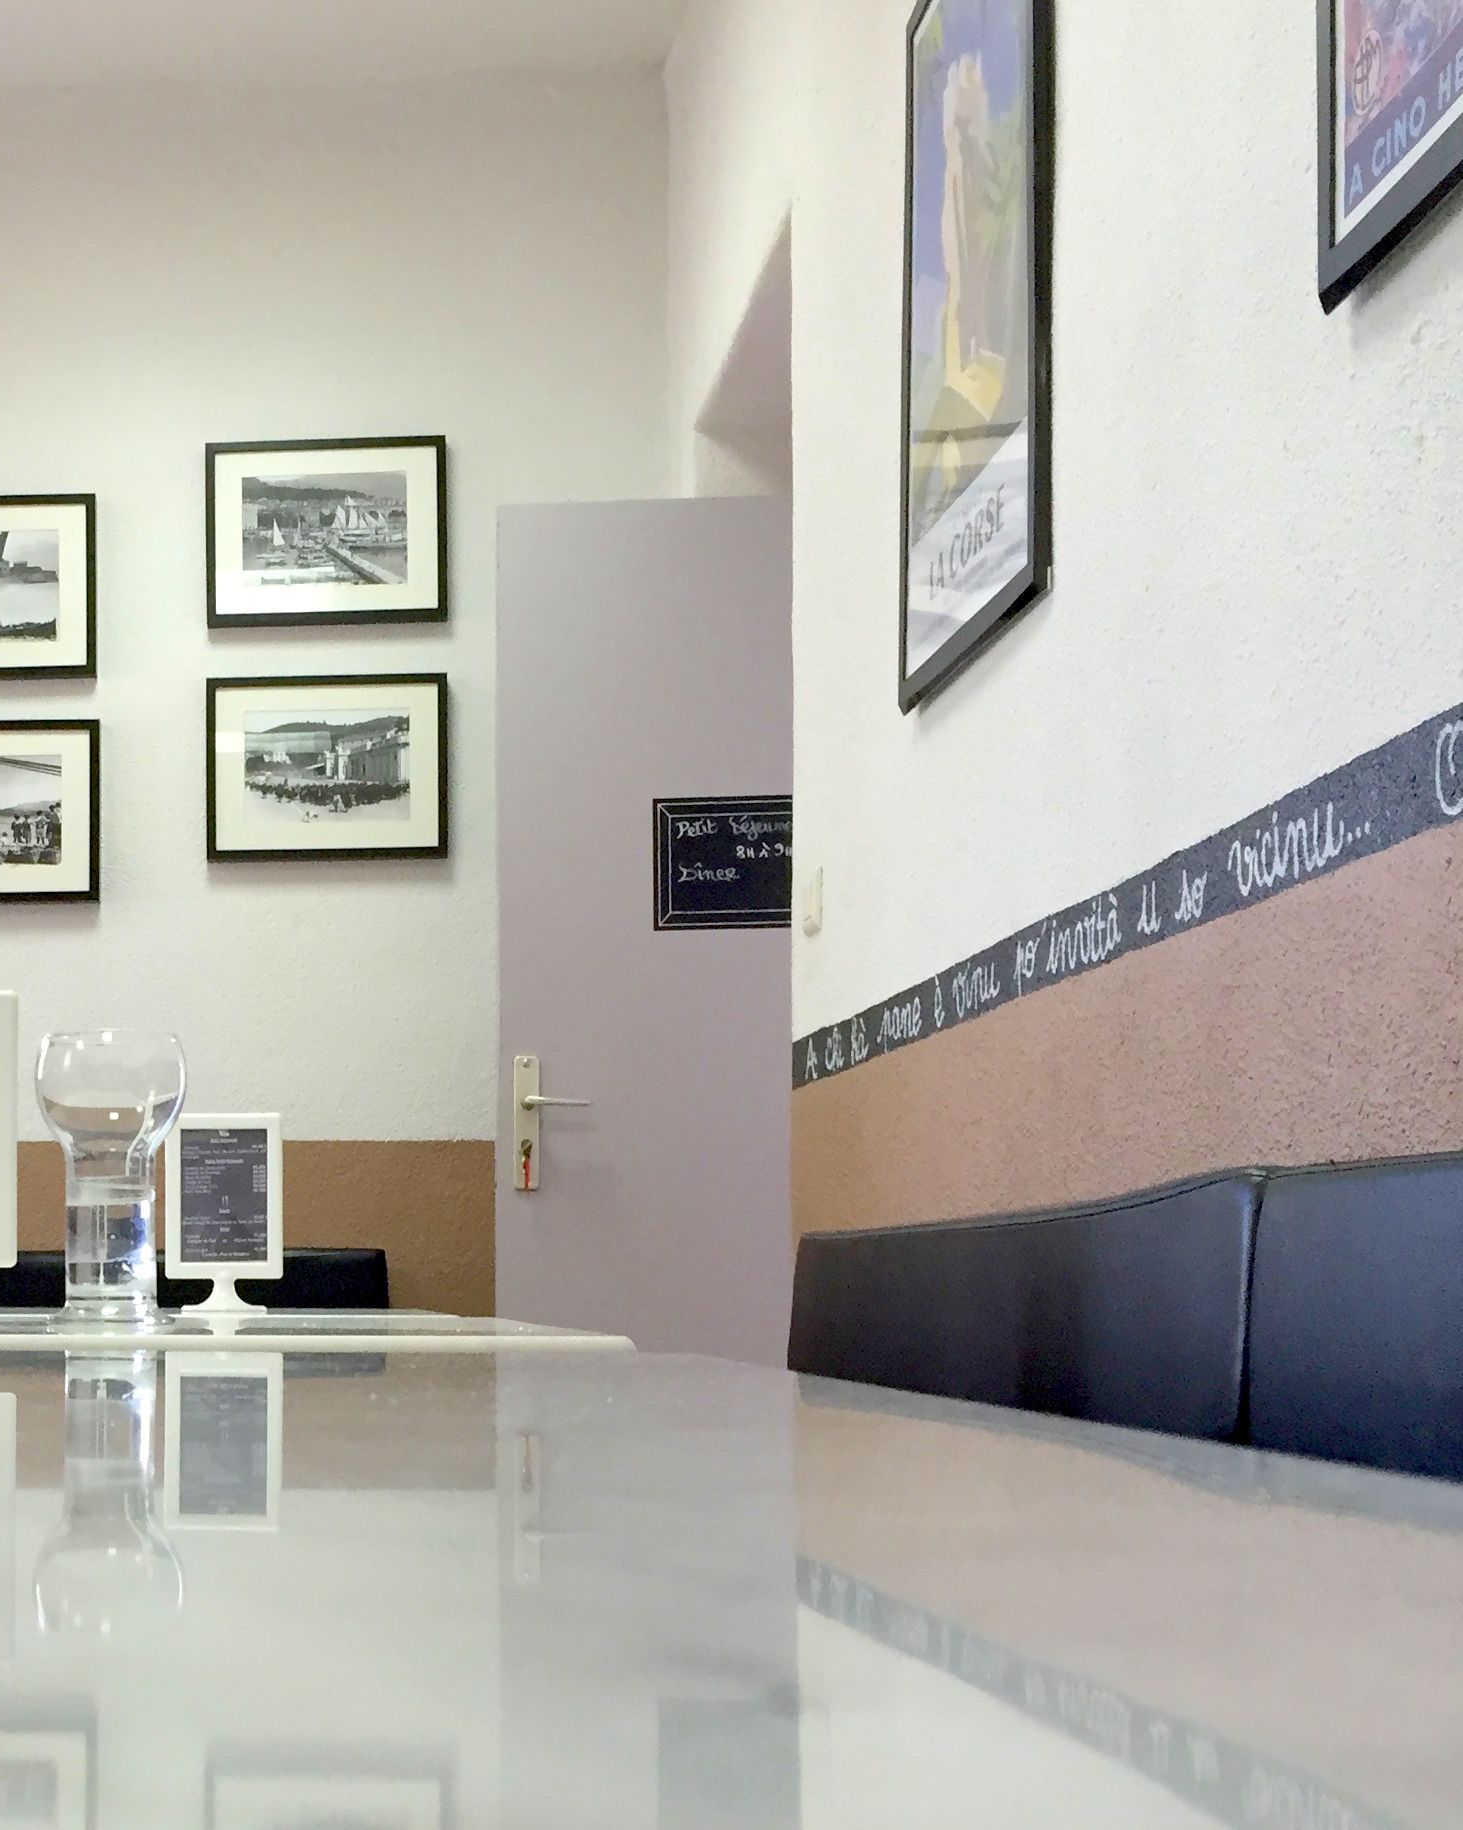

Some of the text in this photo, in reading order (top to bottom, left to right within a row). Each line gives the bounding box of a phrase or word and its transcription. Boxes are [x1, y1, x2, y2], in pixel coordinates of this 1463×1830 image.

[1348, 161, 1365, 206] A
[1371, 95, 1427, 178] CINO
[928, 550, 946, 601] LA
[949, 481, 1006, 580] CORSE
[676, 818, 718, 840] Petit
[805, 1037, 818, 1080] A
[876, 996, 923, 1054] pane
[951, 960, 1001, 1019] vinu
